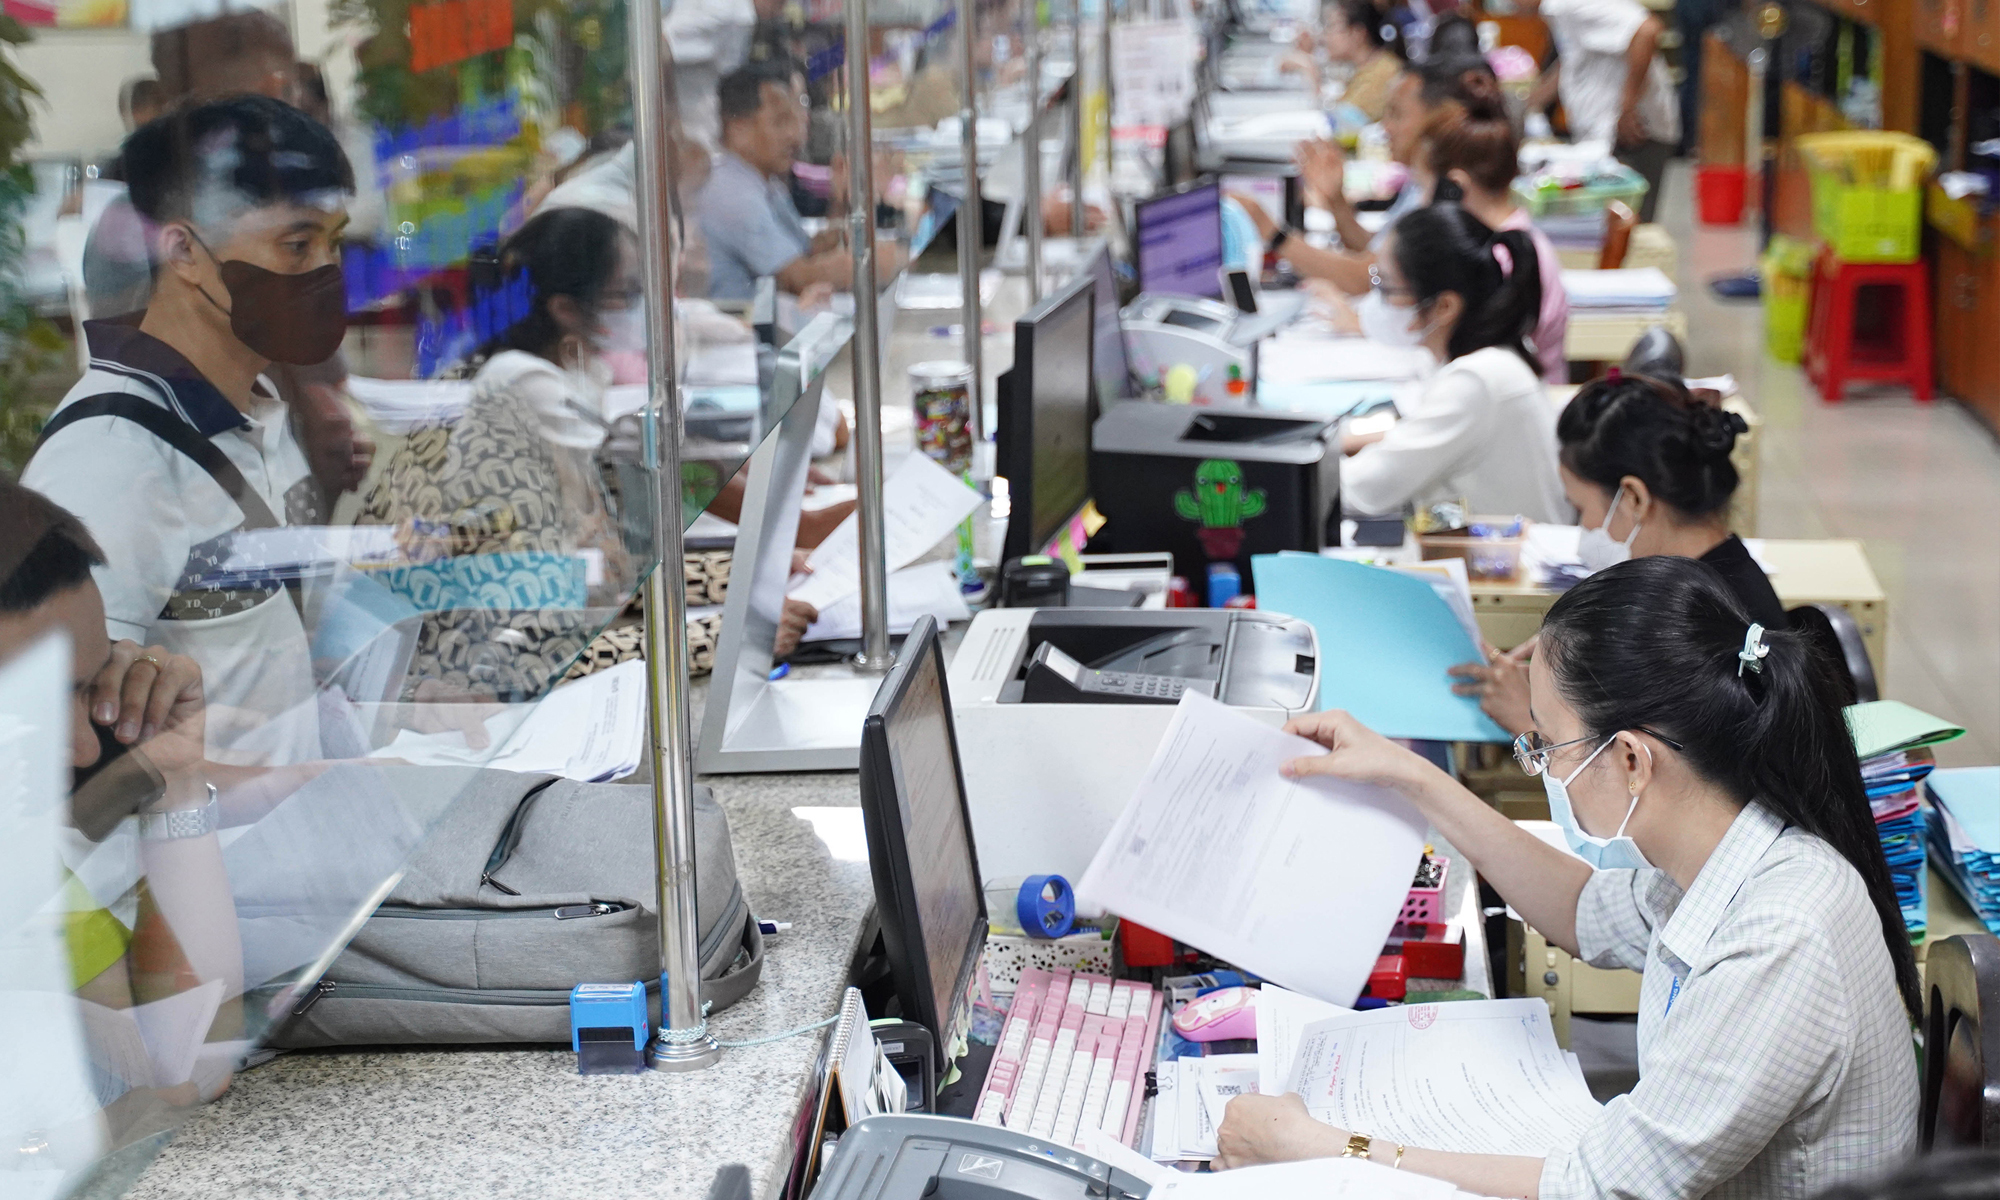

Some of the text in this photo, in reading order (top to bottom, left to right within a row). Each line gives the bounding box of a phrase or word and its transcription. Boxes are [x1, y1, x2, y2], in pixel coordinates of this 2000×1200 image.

[188, 573, 202, 584] YD
[225, 591, 236, 602] YD
[185, 599, 201, 608] YD
[208, 608, 221, 618] YD
